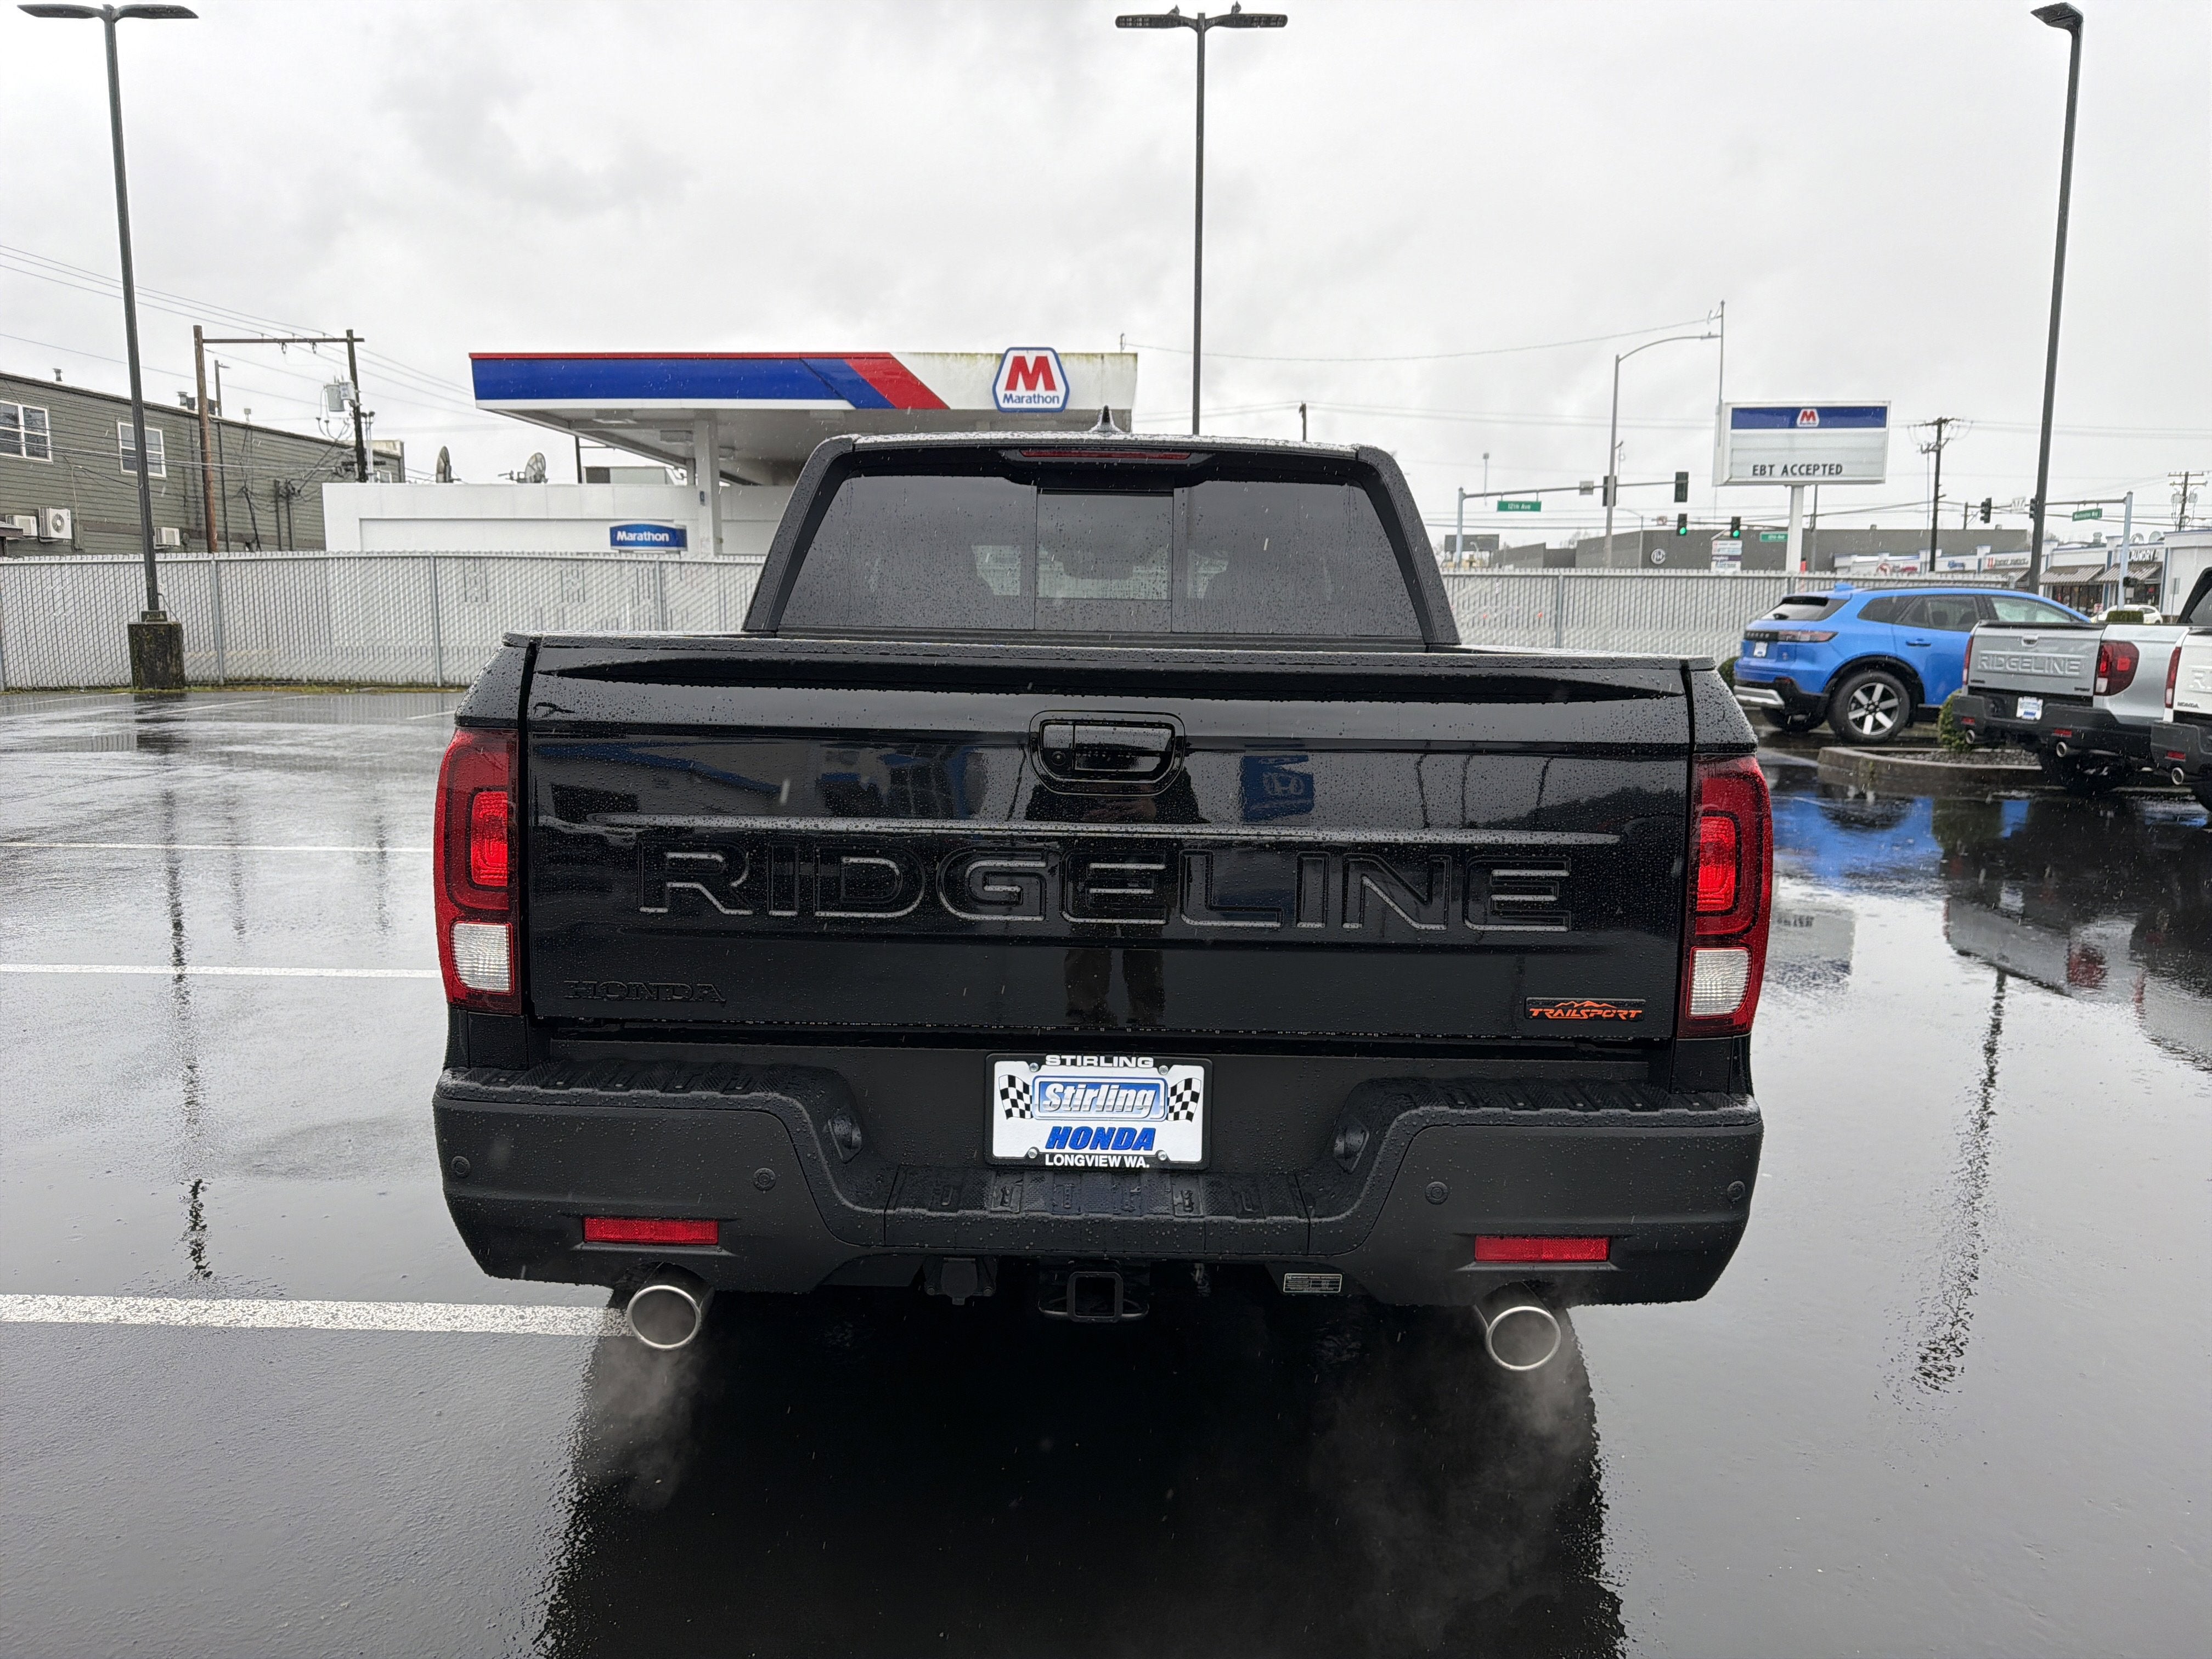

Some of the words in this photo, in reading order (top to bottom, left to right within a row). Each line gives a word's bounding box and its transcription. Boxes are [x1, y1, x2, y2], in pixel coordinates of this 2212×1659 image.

[1005, 356, 1057, 391] M
[1002, 393, 1060, 404] Marathon
[1752, 464, 1775, 476] EBT
[1781, 463, 1843, 476] ACCEPTED
[616, 531, 669, 542] Marathon
[1977, 656, 2081, 675] RIDGELINE
[638, 842, 1573, 933] RIDGELINE
[563, 980, 727, 1002] HONDA
[1529, 1007, 1643, 1020] TRAILSPORT
[1045, 1054, 1154, 1068] STIRLING
[1042, 1083, 1156, 1119] Stirling
[1045, 1126, 1156, 1151] HONDA
[1045, 1154, 1124, 1167] LONGVIEW
[1124, 1156, 1150, 1168] WA.
